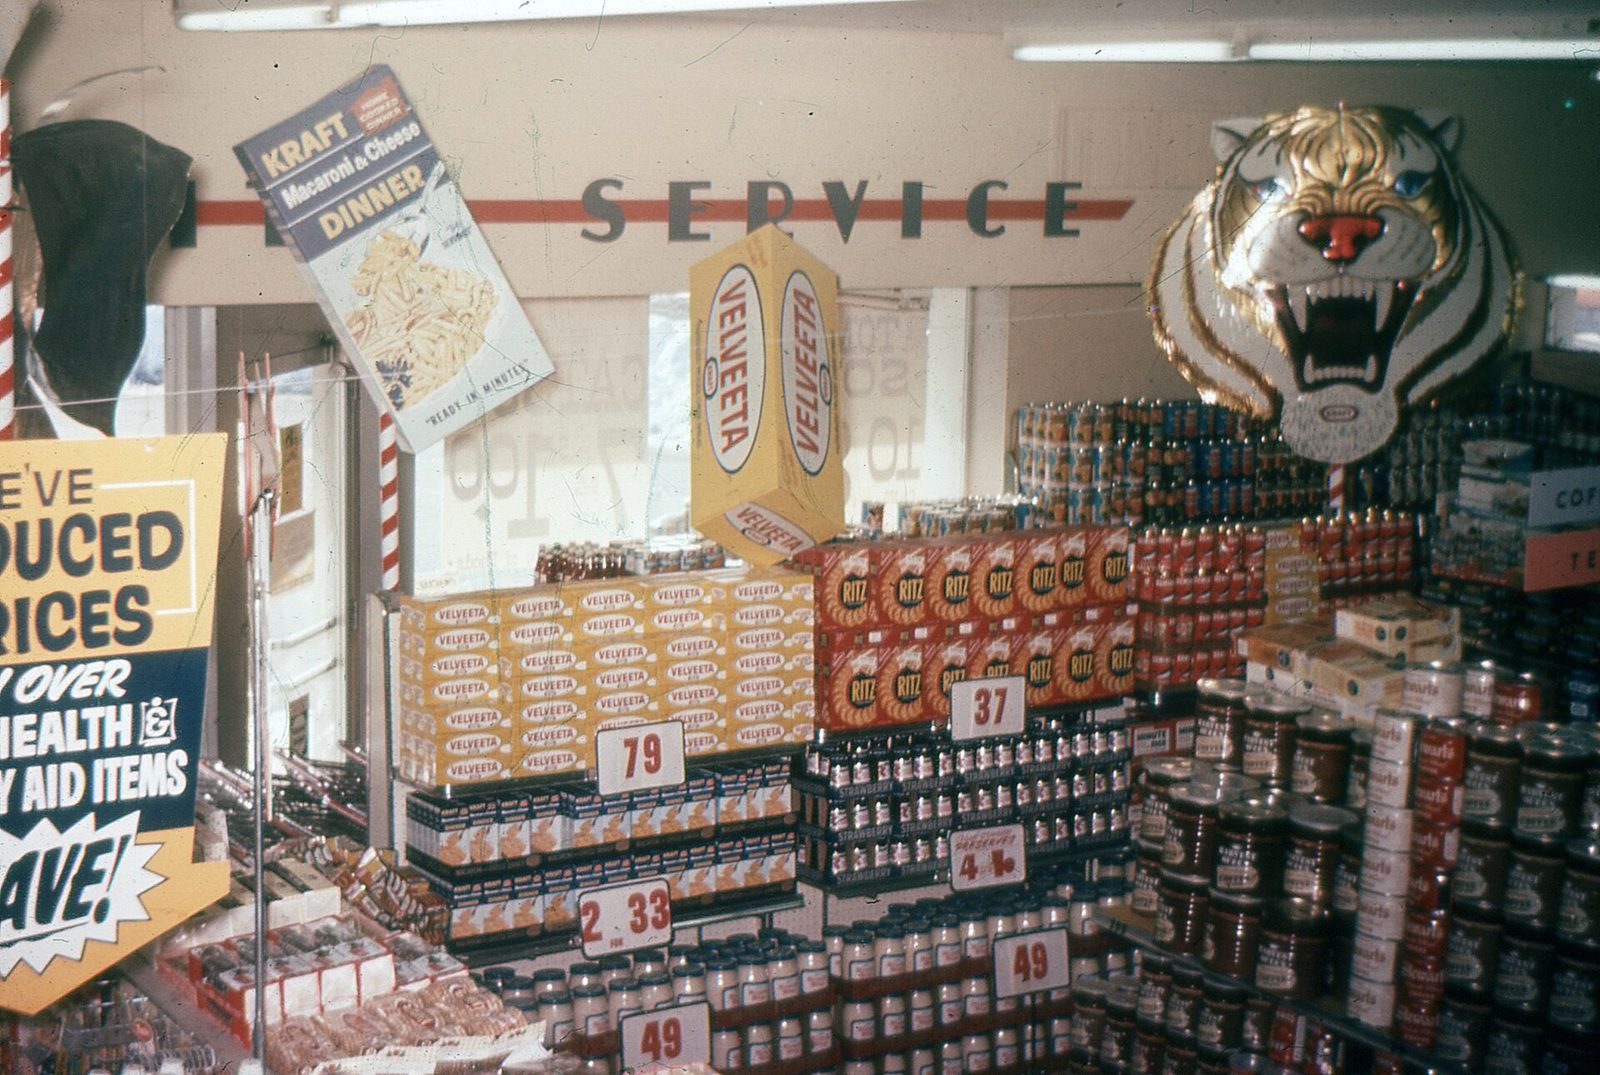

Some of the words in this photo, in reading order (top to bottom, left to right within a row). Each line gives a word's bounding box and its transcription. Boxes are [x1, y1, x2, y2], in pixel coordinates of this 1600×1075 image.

[261, 111, 348, 178] KRAFT
[281, 155, 356, 209] Macaroni
[355, 155, 369, 171] &
[363, 122, 420, 161] Cheese
[320, 166, 425, 240] DINNER
[581, 179, 1083, 245] SERVICE
[719, 279, 749, 456] VELVEETA
[793, 288, 819, 454] VELVEETA
[0, 462, 94, 510] E'VE
[1557, 487, 1600, 509] COF
[737, 507, 803, 551] VELVEETA
[0, 510, 185, 581] UCED
[1032, 567, 1055, 589] RITZ
[1063, 561, 1084, 583] RITZ
[1105, 556, 1127, 578] RITZ
[738, 585, 780, 597] VELVEETA
[843, 581, 867, 602] RITZ
[900, 578, 923, 601] RITZ
[946, 575, 968, 597] RITZ
[990, 571, 1013, 593] RITZ
[586, 593, 630, 606] VELVEETA
[657, 589, 700, 600] VELVEETA
[440, 608, 485, 620] VELVEETA
[588, 618, 631, 630] VELVEETA
[657, 612, 700, 624] VELVEETA
[739, 609, 781, 621] VELVEETA
[440, 633, 486, 645] VELVEETA
[672, 640, 714, 652] VELVEETA
[739, 632, 781, 644] VELVEETA
[437, 658, 484, 670] VELVEETA
[599, 647, 644, 660] VELVEETA
[739, 656, 781, 668] VELVEETA
[1071, 653, 1093, 676] RITZ
[1111, 648, 1133, 670] RITZ
[14, 658, 131, 704] OVER
[600, 672, 645, 684] VELVEETA
[671, 664, 714, 676] VELVEETA
[1030, 659, 1051, 681] RITZ
[438, 683, 485, 696] VELVEETA
[526, 680, 573, 692] VELVEETA
[672, 688, 715, 701] VELVEETA
[739, 681, 780, 693] VELVEETA
[851, 679, 875, 702] RITZ
[898, 674, 921, 696] RITZ
[527, 705, 573, 718] VELVEETA
[601, 696, 645, 708] VELVEETA
[739, 704, 780, 716] VELVEETA
[974, 686, 1008, 726] 37
[145, 706, 171, 738] &
[450, 711, 497, 724] VELVEETA
[450, 737, 497, 750] VELVEETA
[739, 728, 781, 740] VELVEETA
[527, 754, 573, 767] VELVEETA
[623, 733, 661, 779] 79
[451, 762, 498, 775] VELVEETA
[22, 761, 86, 812] AID
[93, 749, 188, 803] ITEMS
[959, 853, 978, 880] 4
[581, 900, 603, 943] 2
[628, 889, 670, 934] 33
[1013, 942, 1048, 982] 49
[640, 1017, 682, 1062] 49
